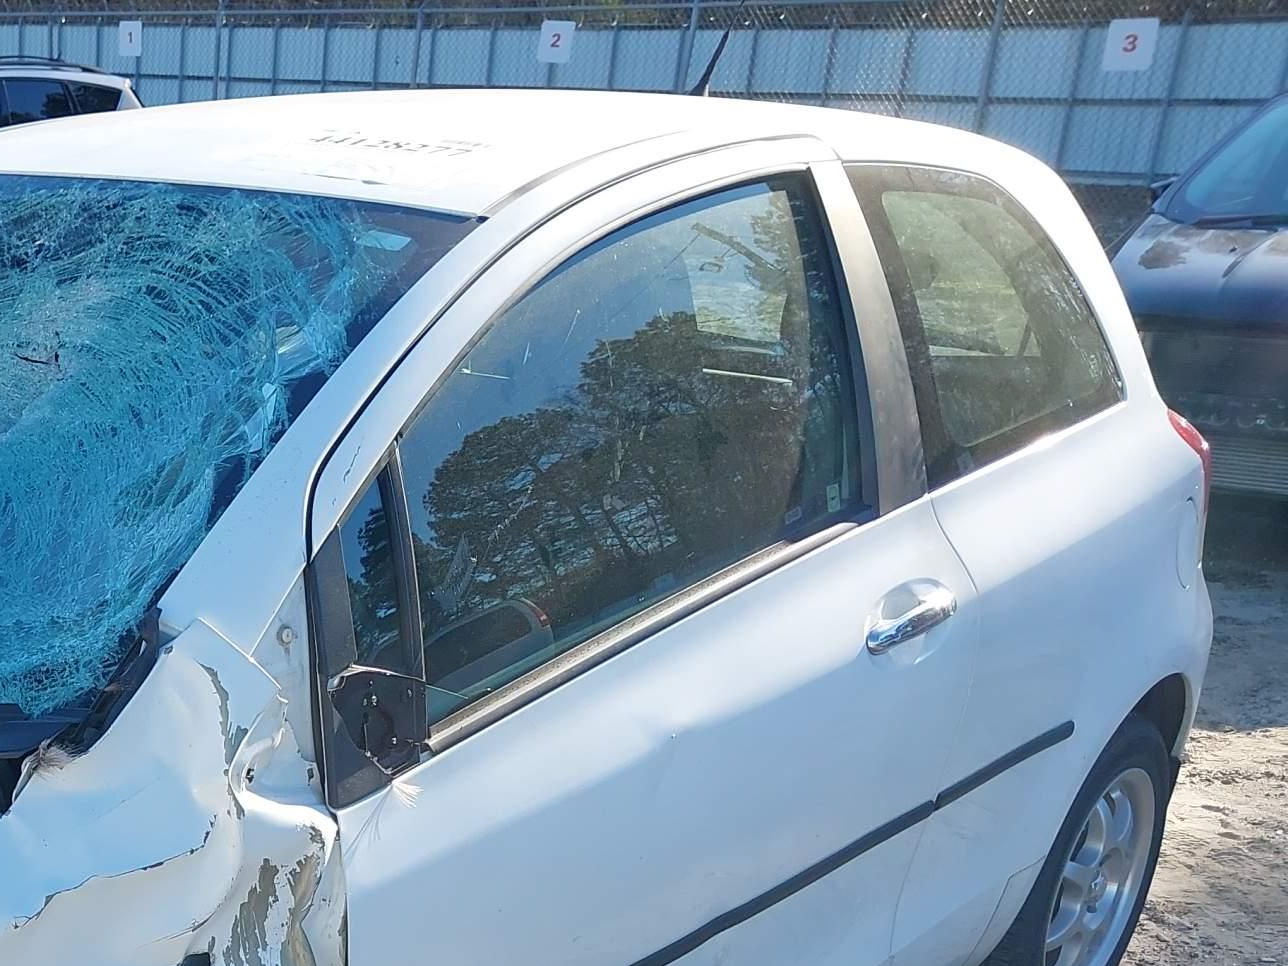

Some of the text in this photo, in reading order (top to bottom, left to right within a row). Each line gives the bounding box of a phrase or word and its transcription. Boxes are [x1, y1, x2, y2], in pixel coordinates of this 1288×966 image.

[127, 31, 133, 44] 1
[550, 33, 561, 48] 2
[1122, 34, 1138, 53] 3
